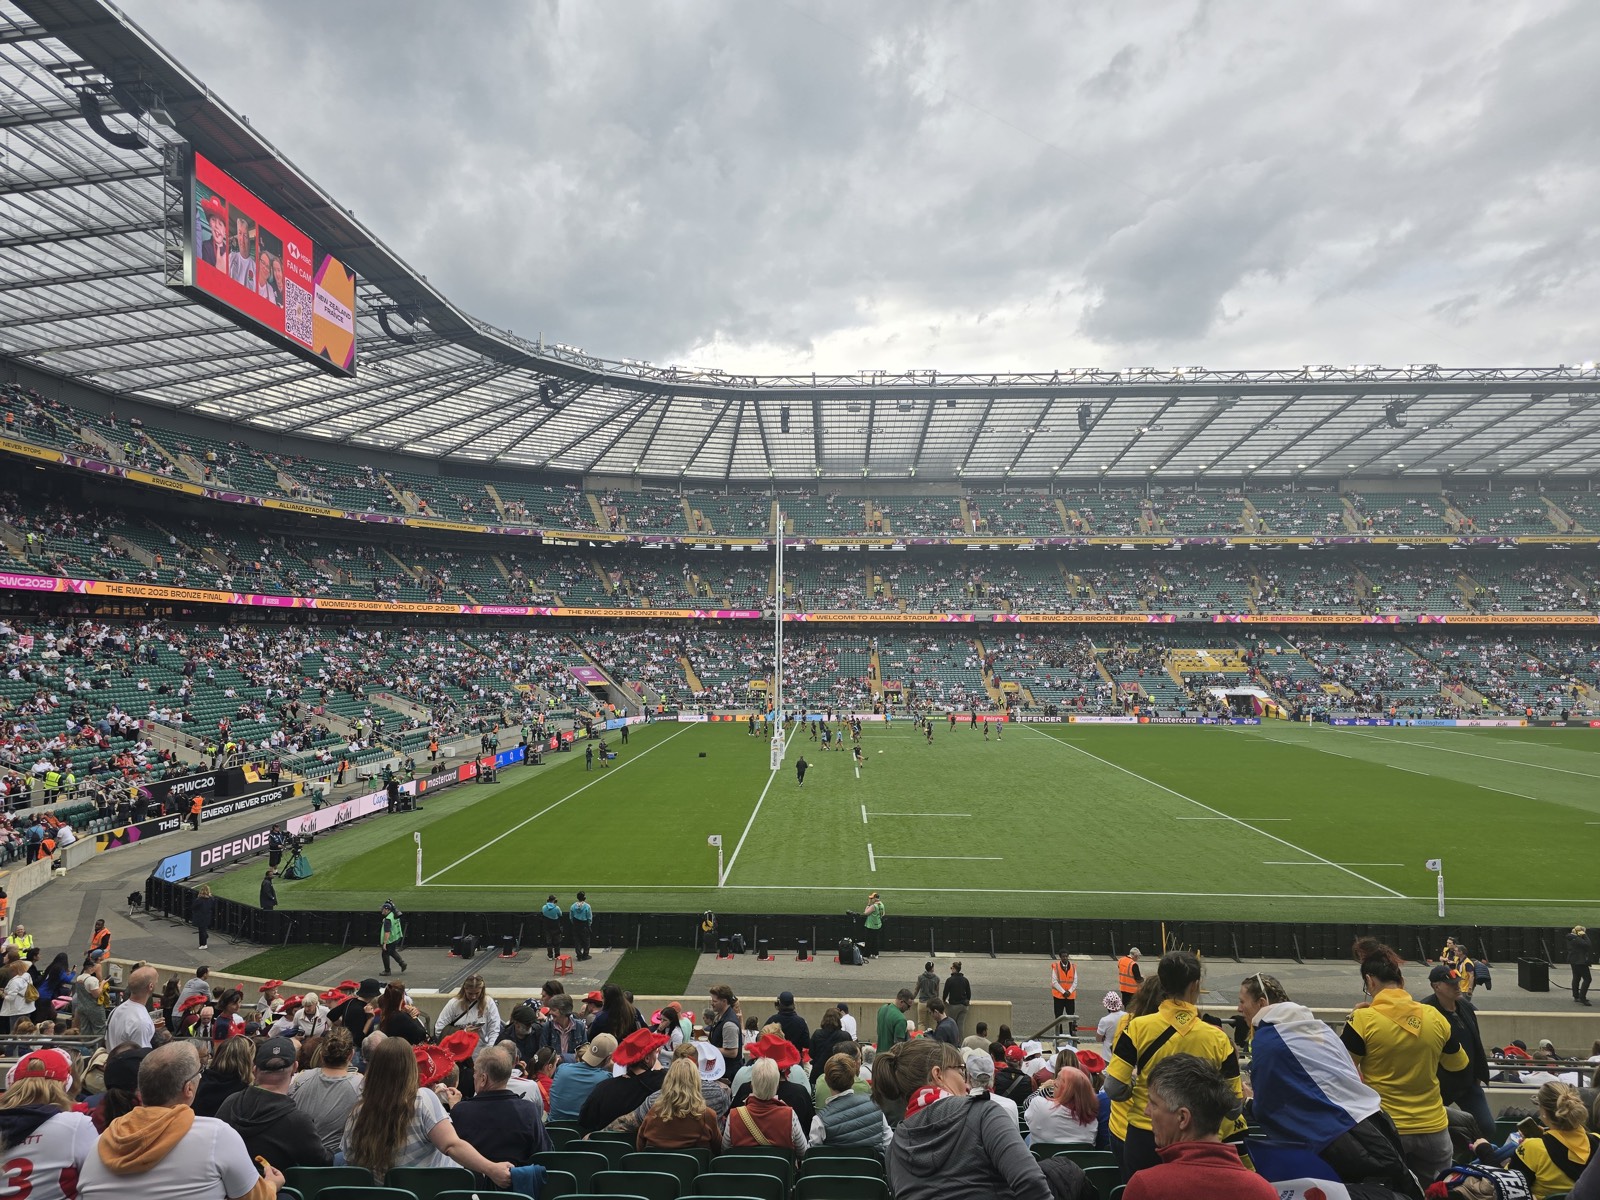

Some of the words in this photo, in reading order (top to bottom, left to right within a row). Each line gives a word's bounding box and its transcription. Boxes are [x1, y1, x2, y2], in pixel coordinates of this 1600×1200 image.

[286, 260, 298, 274] FAN
[300, 268, 312, 283] CAM
[316, 292, 328, 305] NEW
[329, 301, 352, 320] ZEALAND
[324, 306, 344, 324] FRANCE
[3, 442, 22, 451] NEVER
[24, 445, 42, 455] STOPS
[152, 477, 183, 489] #RWC2025
[278, 502, 304, 511] ALLIANZ
[304, 506, 330, 515] STADIUM
[106, 585, 123, 593] THE
[126, 587, 146, 595] RWC
[148, 588, 169, 597] 2025
[171, 590, 201, 599] BRONZE
[203, 592, 223, 600] FINAL
[427, 770, 457, 788] mastercard
[159, 818, 179, 831] THIS
[202, 803, 234, 819] ENERGY
[235, 797, 260, 810] NEVER
[260, 791, 282, 803] STOPS
[334, 808, 352, 824] Asahi
[298, 818, 316, 834] Asahi
[201, 830, 271, 867] DEFENDE
[162, 864, 178, 878] er
